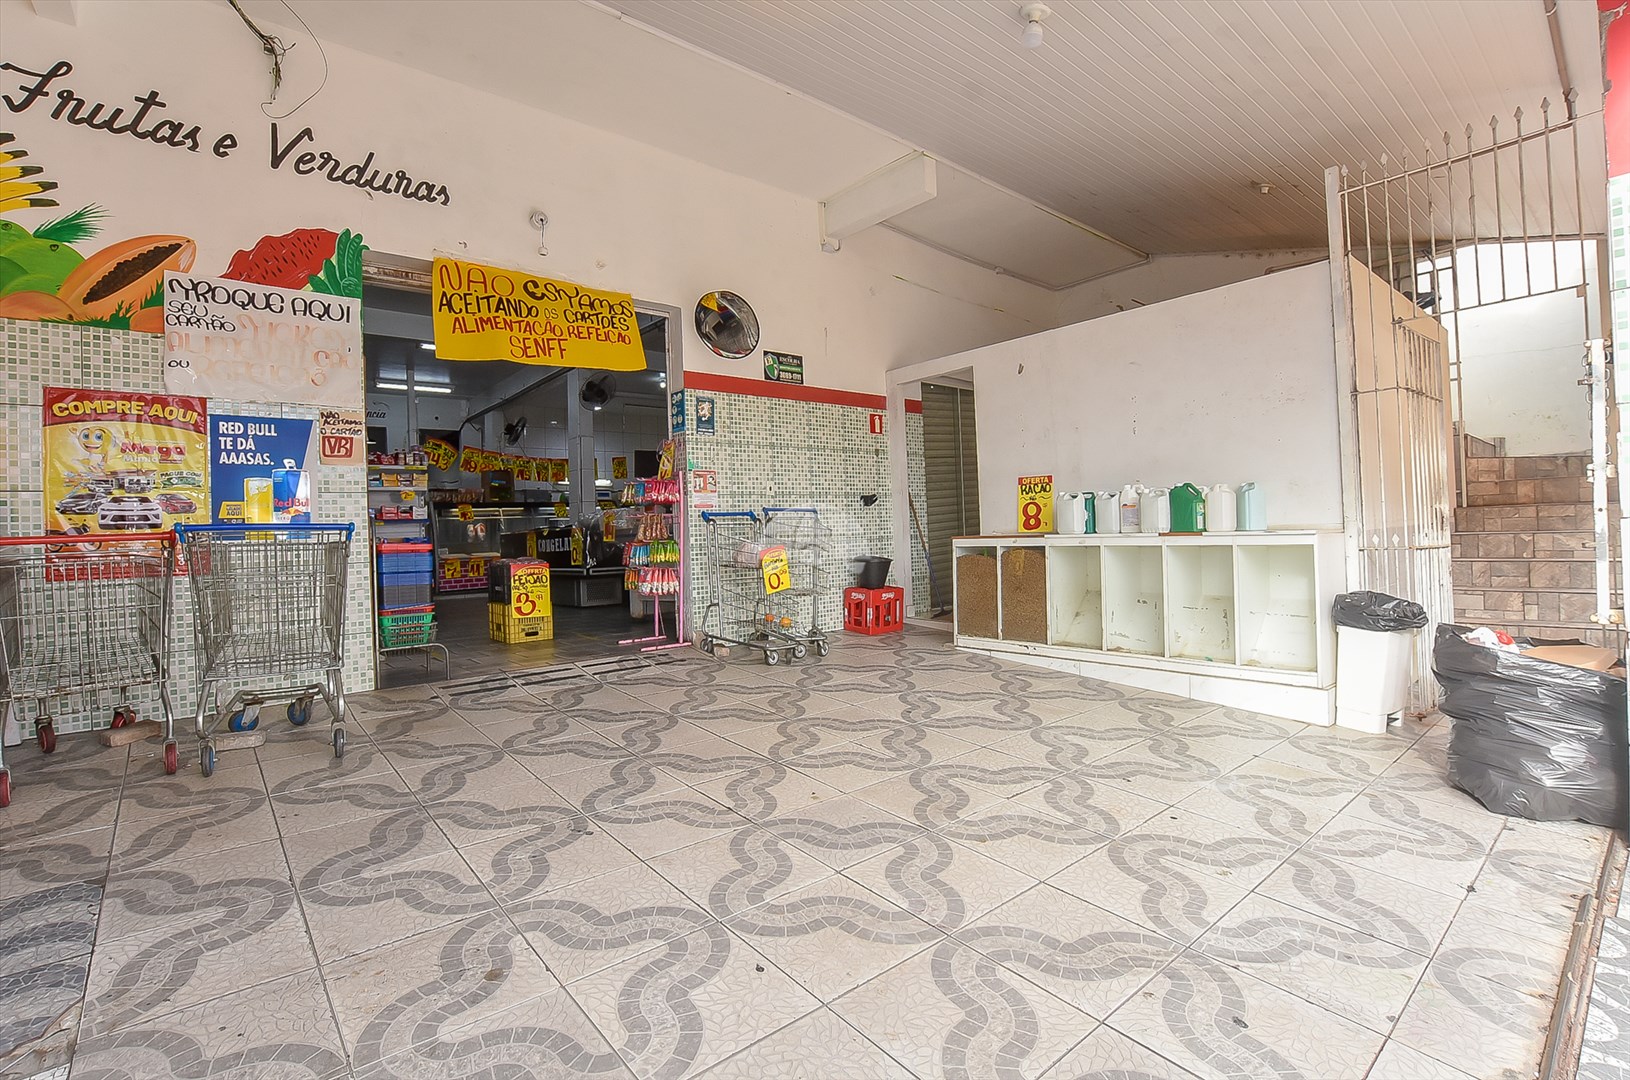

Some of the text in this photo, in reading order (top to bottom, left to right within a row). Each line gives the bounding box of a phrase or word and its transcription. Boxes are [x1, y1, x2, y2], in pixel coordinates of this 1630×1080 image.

[0, 61, 451, 206] Frutas e Verduras
[439, 261, 515, 297] NÃO
[167, 300, 209, 317] SEU
[168, 278, 351, 323] TROQUE AQUI
[438, 289, 539, 319] ACEITANDO
[544, 307, 559, 319] OS
[165, 313, 236, 333] CARTÃO
[509, 335, 568, 359] SENFF
[52, 400, 199, 425] COMPRE AQUI
[219, 421, 278, 436] RED BULL
[219, 435, 255, 450] TE DÁ
[219, 451, 275, 465] AAASAS.
[1023, 502, 1043, 531] 8
